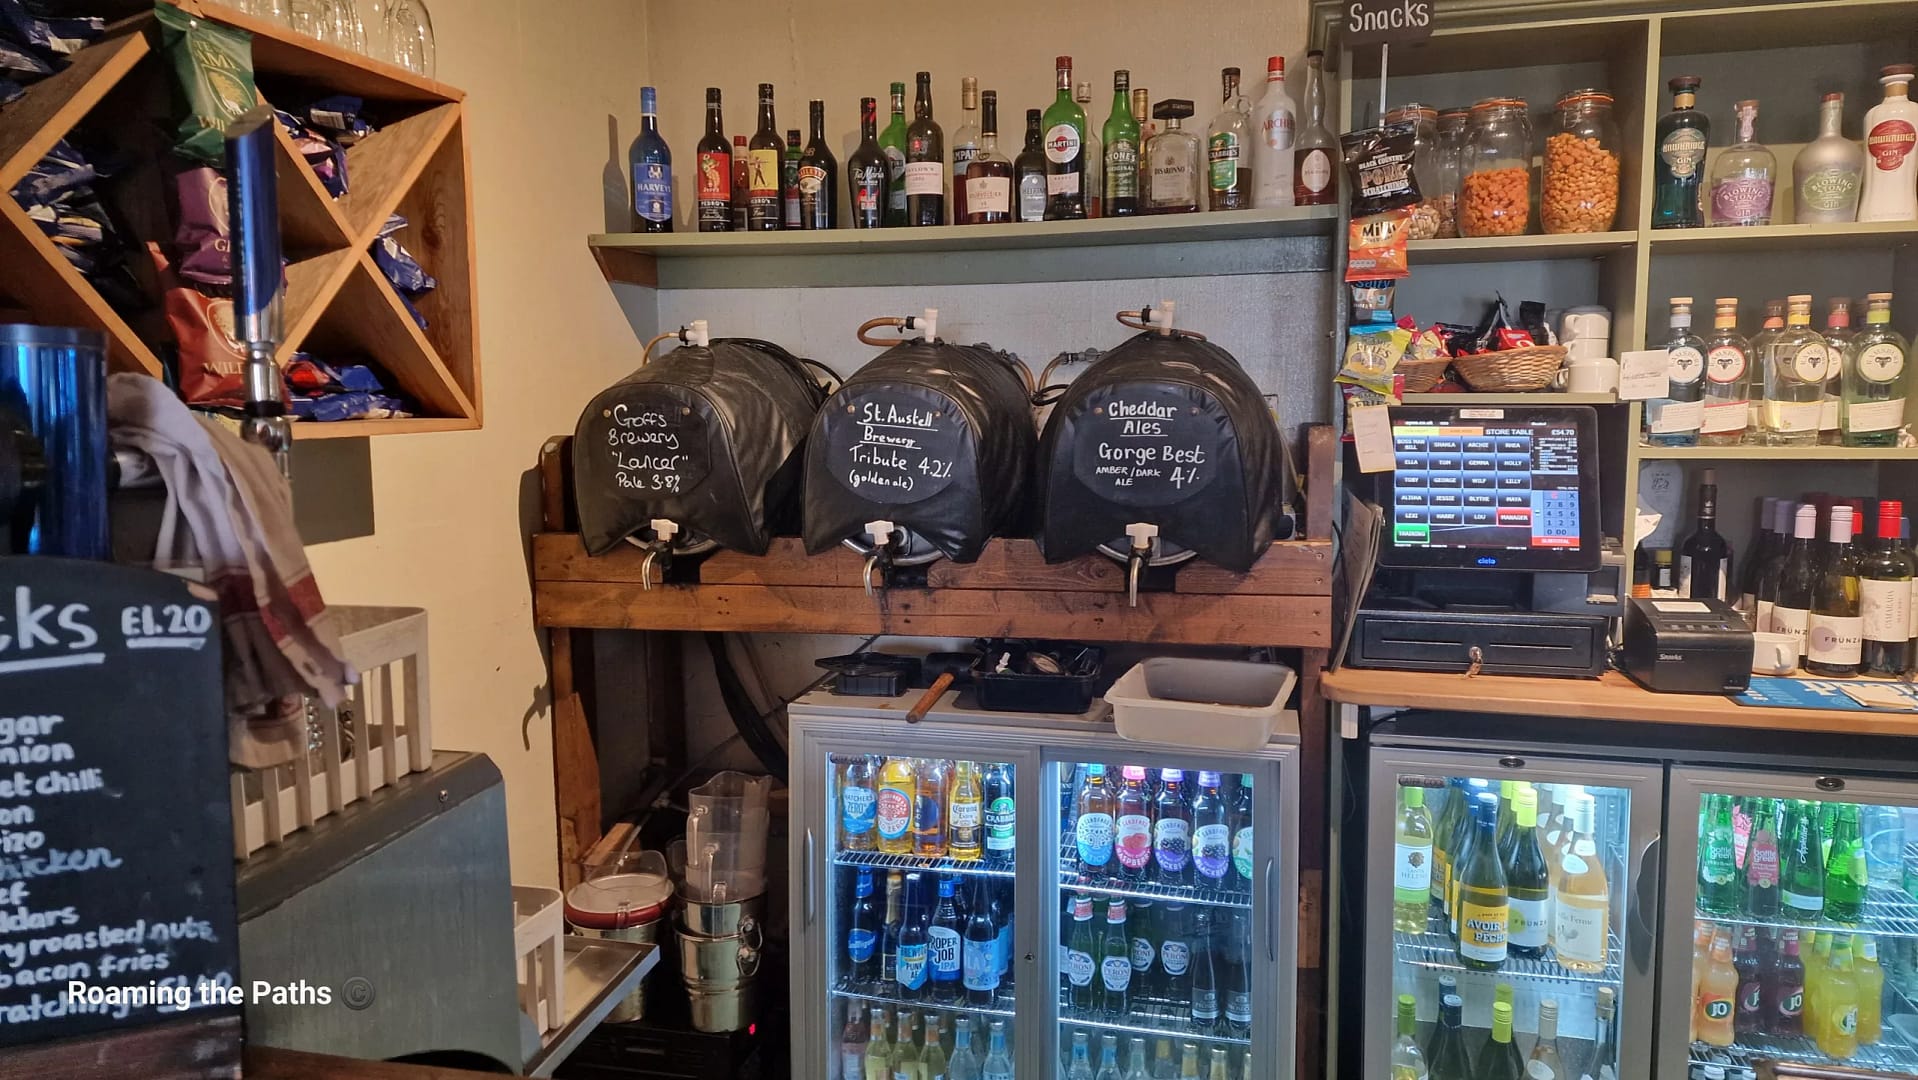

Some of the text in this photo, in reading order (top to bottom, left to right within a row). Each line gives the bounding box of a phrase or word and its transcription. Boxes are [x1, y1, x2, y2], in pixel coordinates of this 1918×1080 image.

[1349, 0, 1430, 33] Snacks
[1047, 138, 1078, 149] MARTINI
[1882, 149, 1898, 158] GIN
[1360, 162, 1408, 189] PORK
[613, 404, 667, 427] Goffs
[887, 404, 933, 428] Austell
[1108, 400, 1178, 418] Cheddar
[863, 425, 918, 448] Brewery
[1123, 420, 1162, 435] Ales
[608, 428, 680, 449] Brewery
[849, 443, 953, 478] Tribute 4.2%
[1098, 442, 1206, 466] Gorge Best
[616, 471, 645, 489] Pale
[849, 469, 890, 489] (golden
[1114, 477, 1133, 486] ALE
[1169, 466, 1201, 489] 4%
[1776, 626, 1808, 635] FRUNZ
[1466, 919, 1500, 931] AVOIR
[29, 919, 146, 956] roasted
[98, 950, 170, 978] fries
[934, 946, 955, 965] JOB
